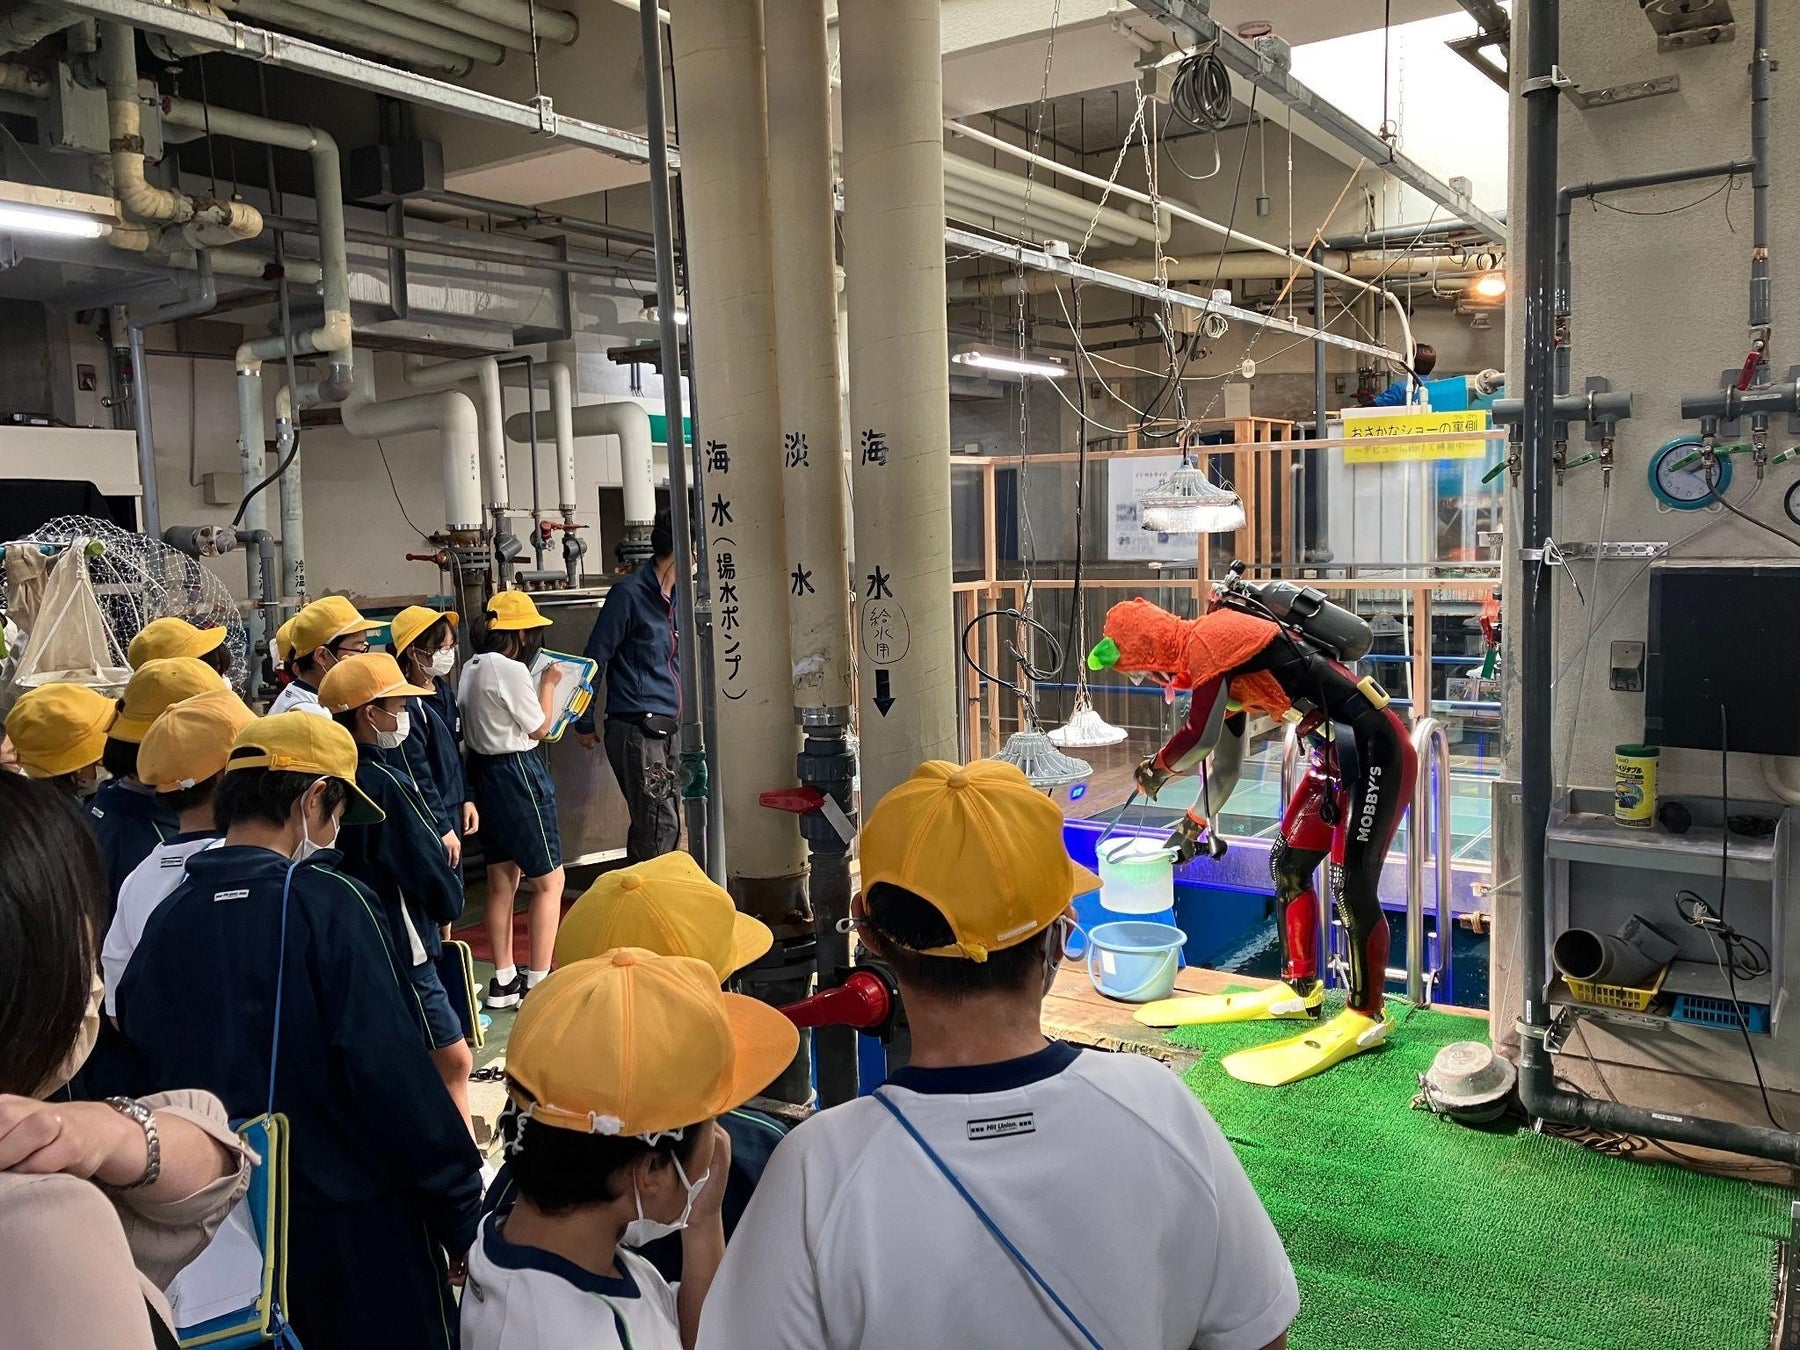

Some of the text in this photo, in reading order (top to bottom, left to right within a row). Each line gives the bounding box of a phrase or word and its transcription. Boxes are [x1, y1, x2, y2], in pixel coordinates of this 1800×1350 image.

[785, 431, 815, 596] 淡水
[861, 429, 894, 600] 海水
[870, 607, 893, 659] 給水用
[1356, 766, 1382, 842] MOBBY'S
